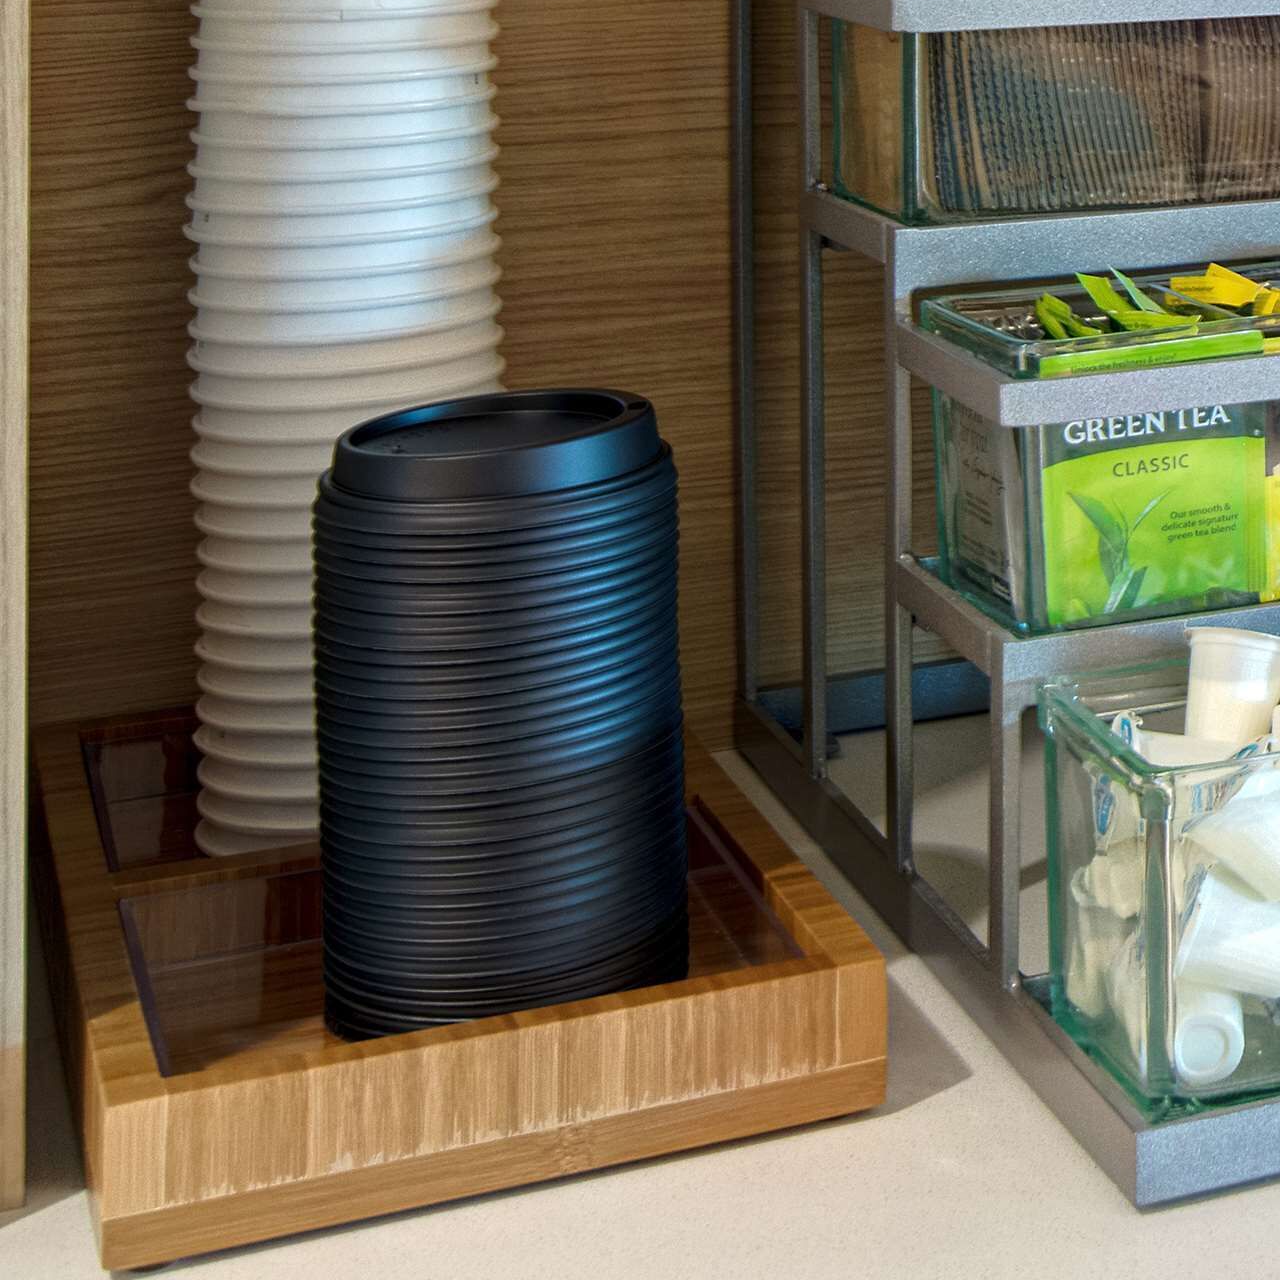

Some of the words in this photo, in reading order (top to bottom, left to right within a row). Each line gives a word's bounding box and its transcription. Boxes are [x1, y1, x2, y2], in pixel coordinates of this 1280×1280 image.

[1063, 410, 1166, 444] GREEN
[1171, 404, 1231, 431] TEA
[1112, 453, 1190, 477] CLASSIC
[1170, 510, 1187, 520] Our
[1188, 505, 1223, 517] smooth
[1224, 503, 1231, 511] &
[1161, 520, 1198, 532] delicate
[1167, 531, 1193, 543] green
[1195, 529, 1209, 538] tea
[1211, 523, 1236, 535] blend
